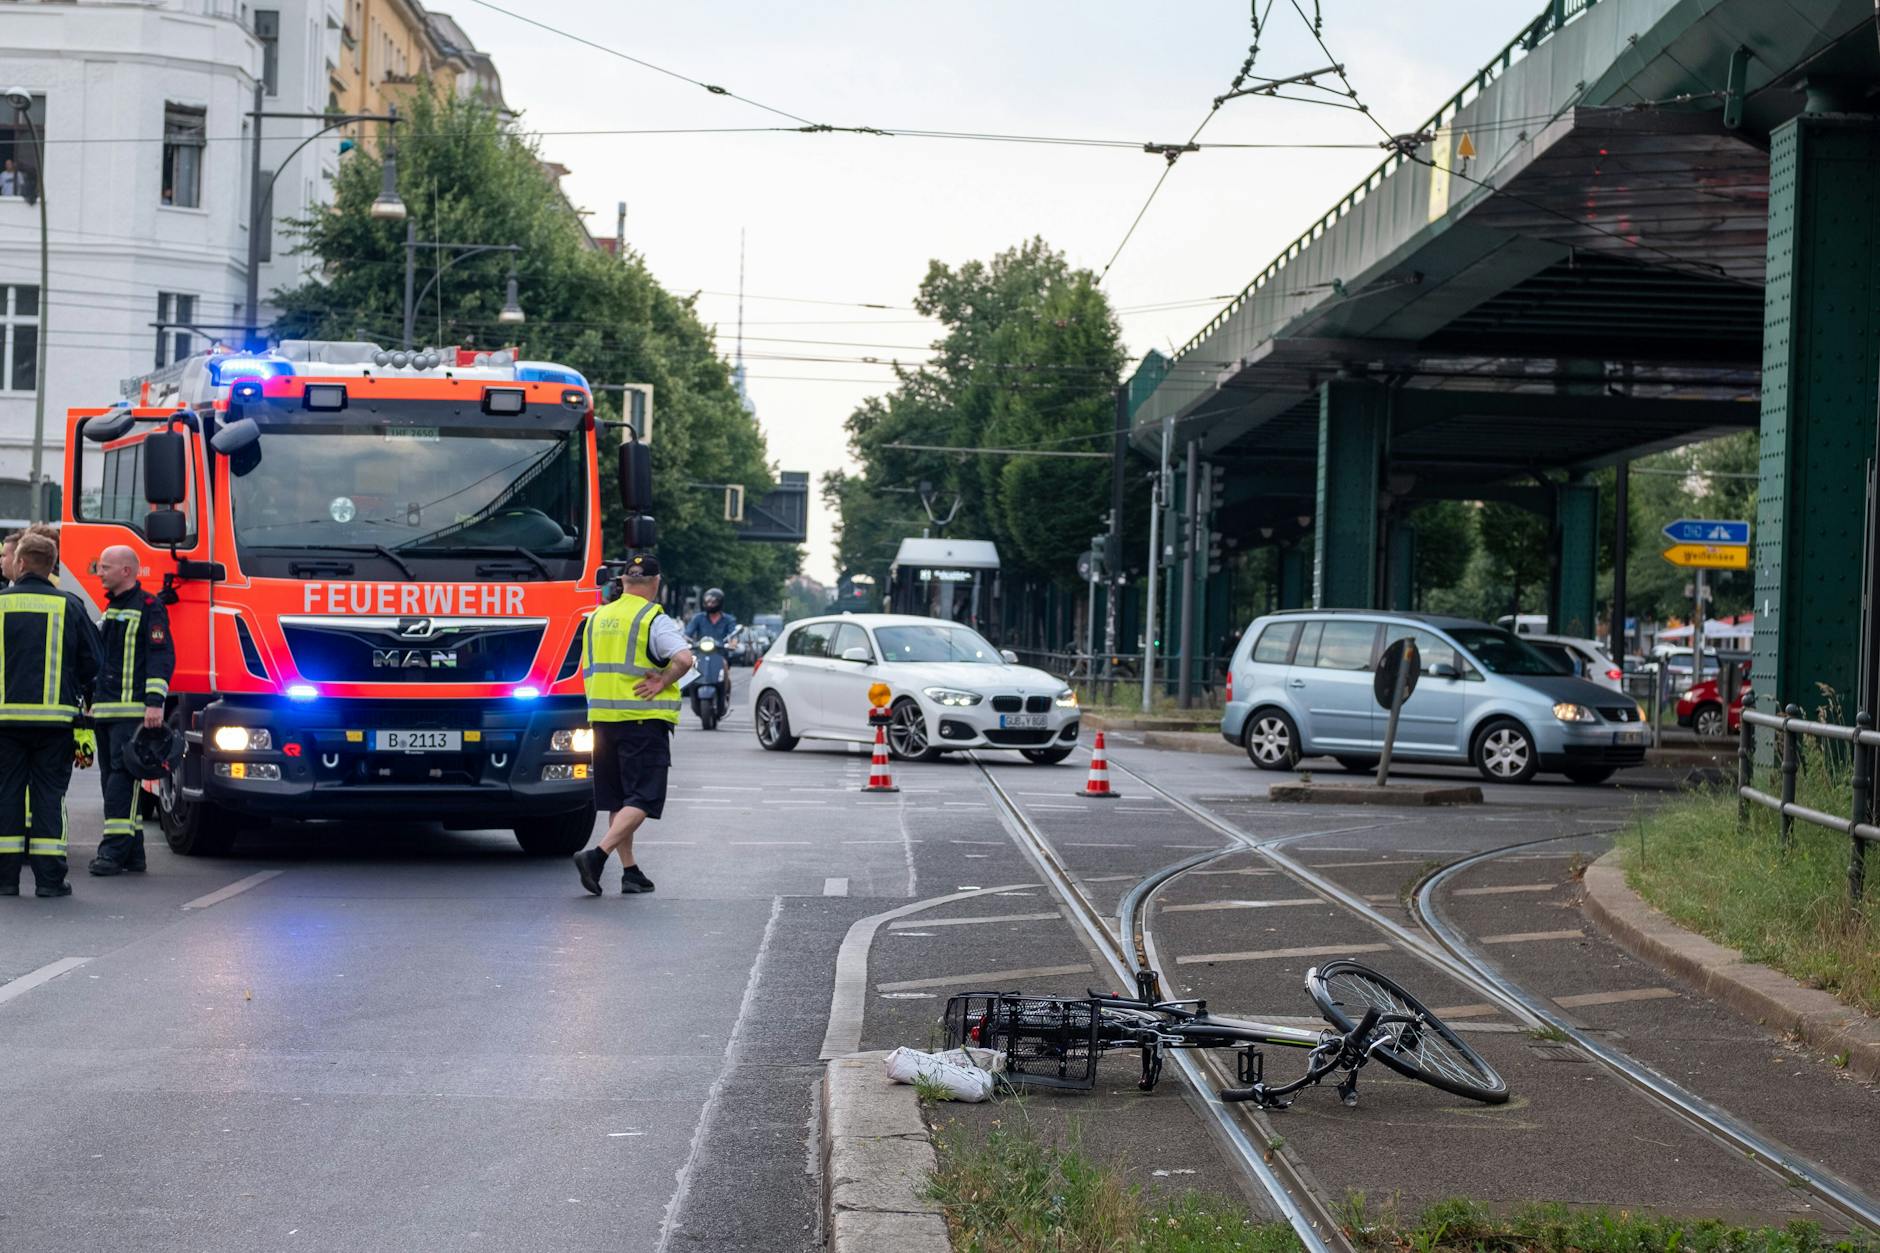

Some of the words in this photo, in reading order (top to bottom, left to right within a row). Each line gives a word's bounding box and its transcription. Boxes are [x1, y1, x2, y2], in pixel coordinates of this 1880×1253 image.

[303, 583, 525, 615] FEUERWEHR
[373, 650, 457, 668] MAN
[388, 733, 398, 748] B
[409, 733, 447, 748] 2113
